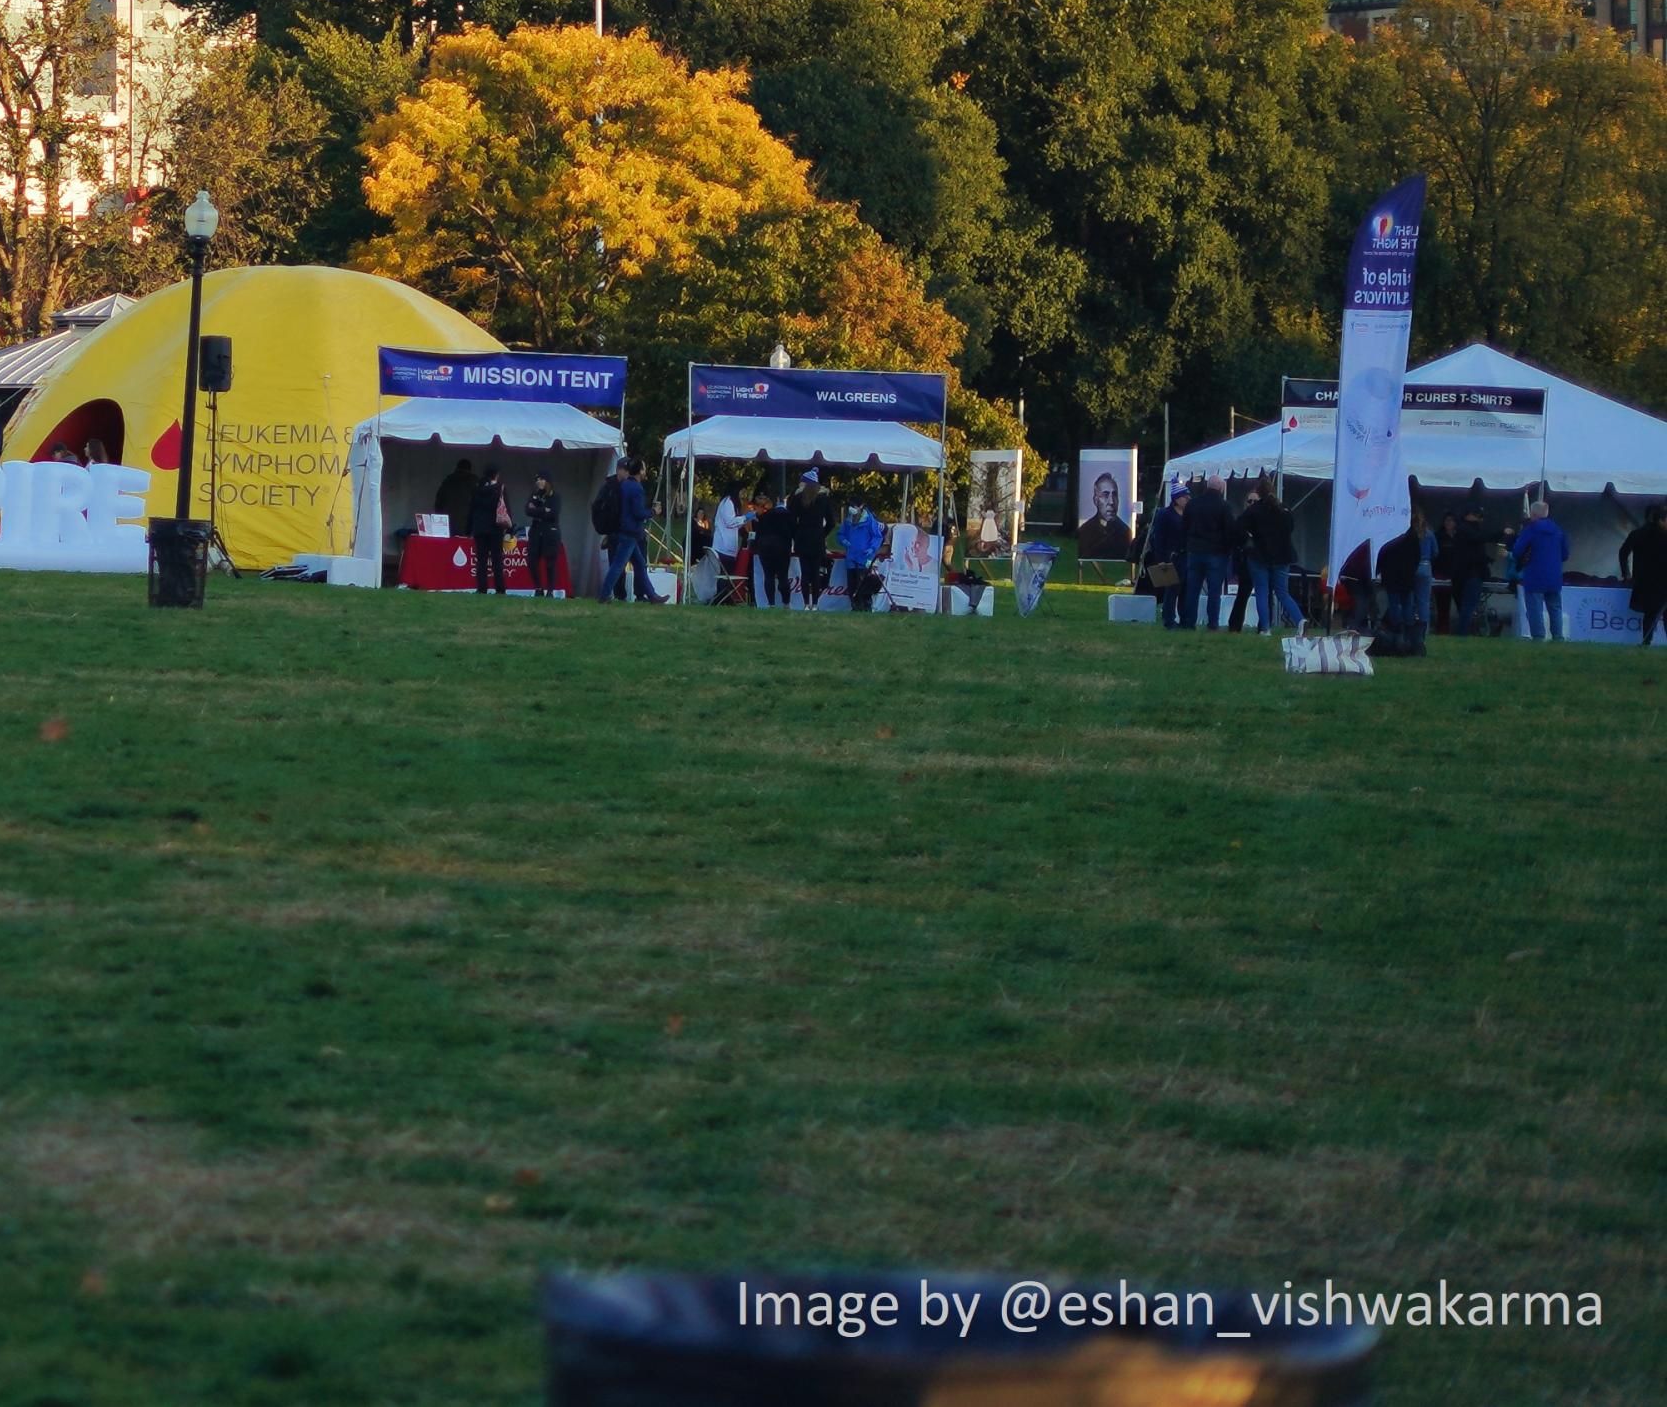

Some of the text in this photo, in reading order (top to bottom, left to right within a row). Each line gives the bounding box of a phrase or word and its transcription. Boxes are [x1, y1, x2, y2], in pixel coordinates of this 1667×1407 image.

[463, 366, 614, 390] MISSION TENT
[816, 391, 897, 404] WALGREENS
[1315, 391, 1339, 401] CHA
[1416, 393, 1457, 403] CURES
[1460, 393, 1513, 406] T-SHIRTS
[205, 423, 338, 444] LEUKEMIA
[1419, 419, 1452, 428] Sponsored
[202, 452, 341, 475] LYMPHOM
[198, 482, 320, 506] SOCIETY
[1591, 609, 1642, 632] Bea
